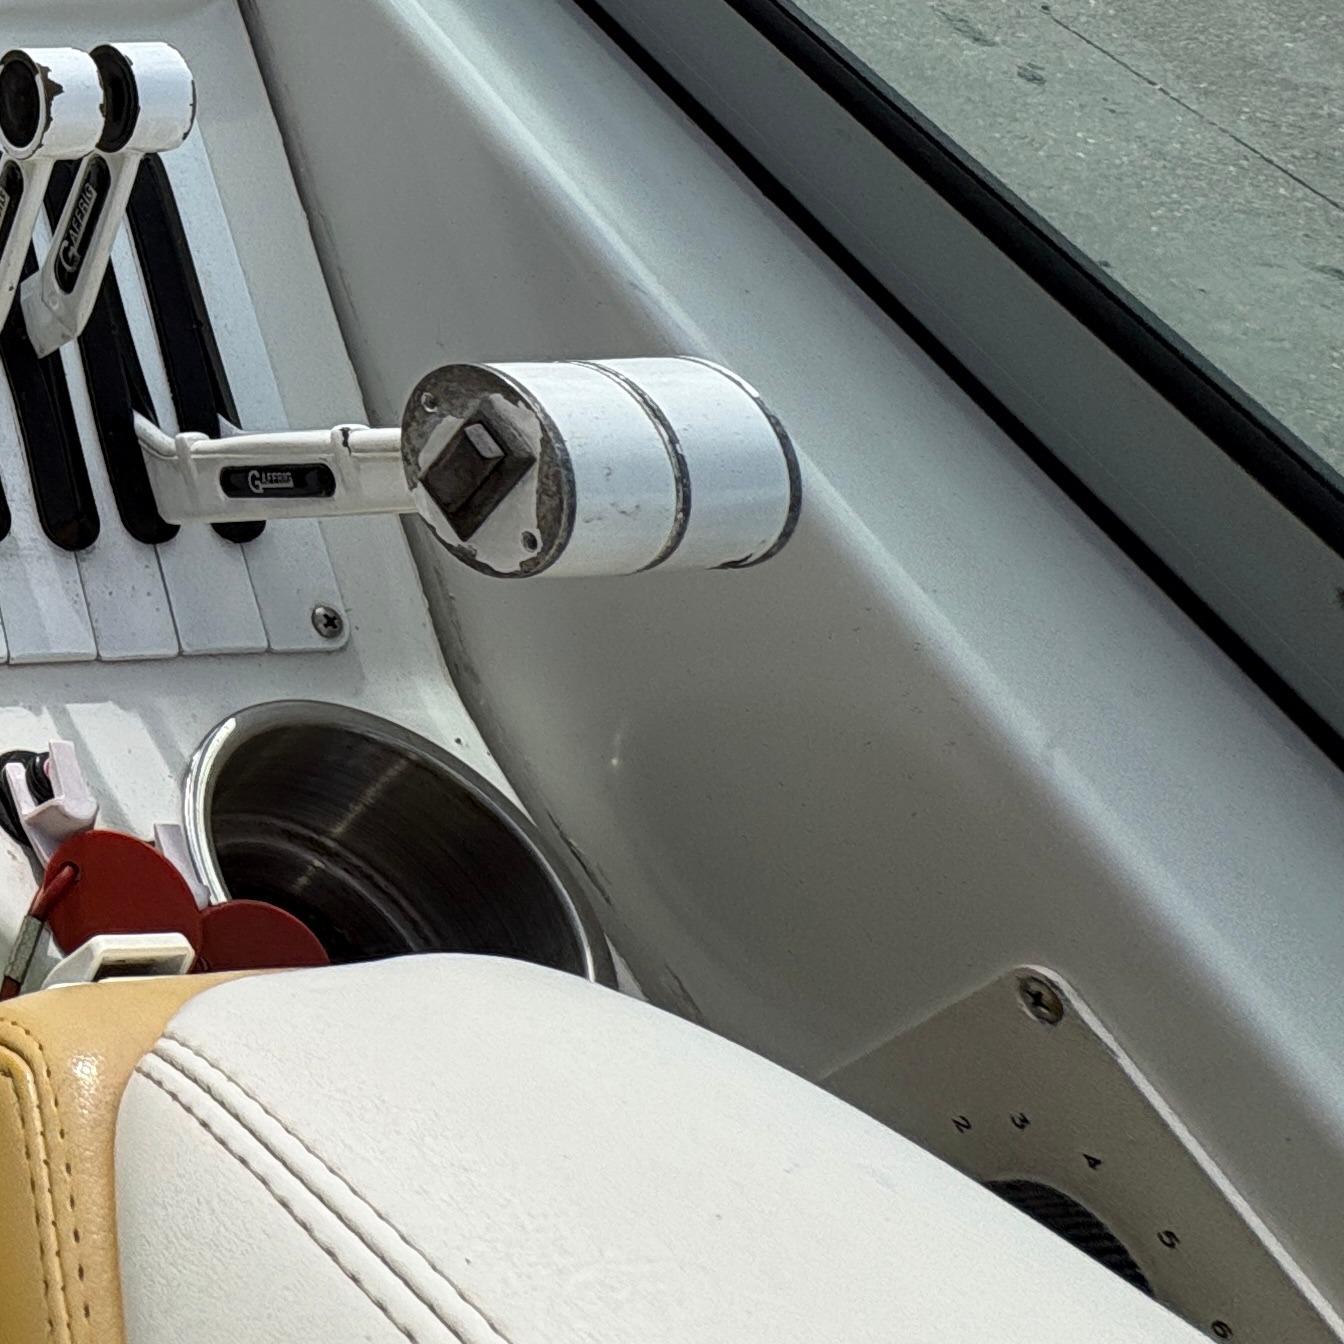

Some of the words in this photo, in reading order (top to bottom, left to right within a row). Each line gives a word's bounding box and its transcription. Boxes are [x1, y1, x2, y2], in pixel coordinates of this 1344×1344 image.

[59, 182, 97, 273] GAFFRIG
[951, 1115, 972, 1134] 2
[1010, 1113, 1030, 1130] 3
[1083, 1154, 1102, 1170] 4
[1157, 1230, 1180, 1248] 5
[1211, 1319, 1233, 1340] 6
